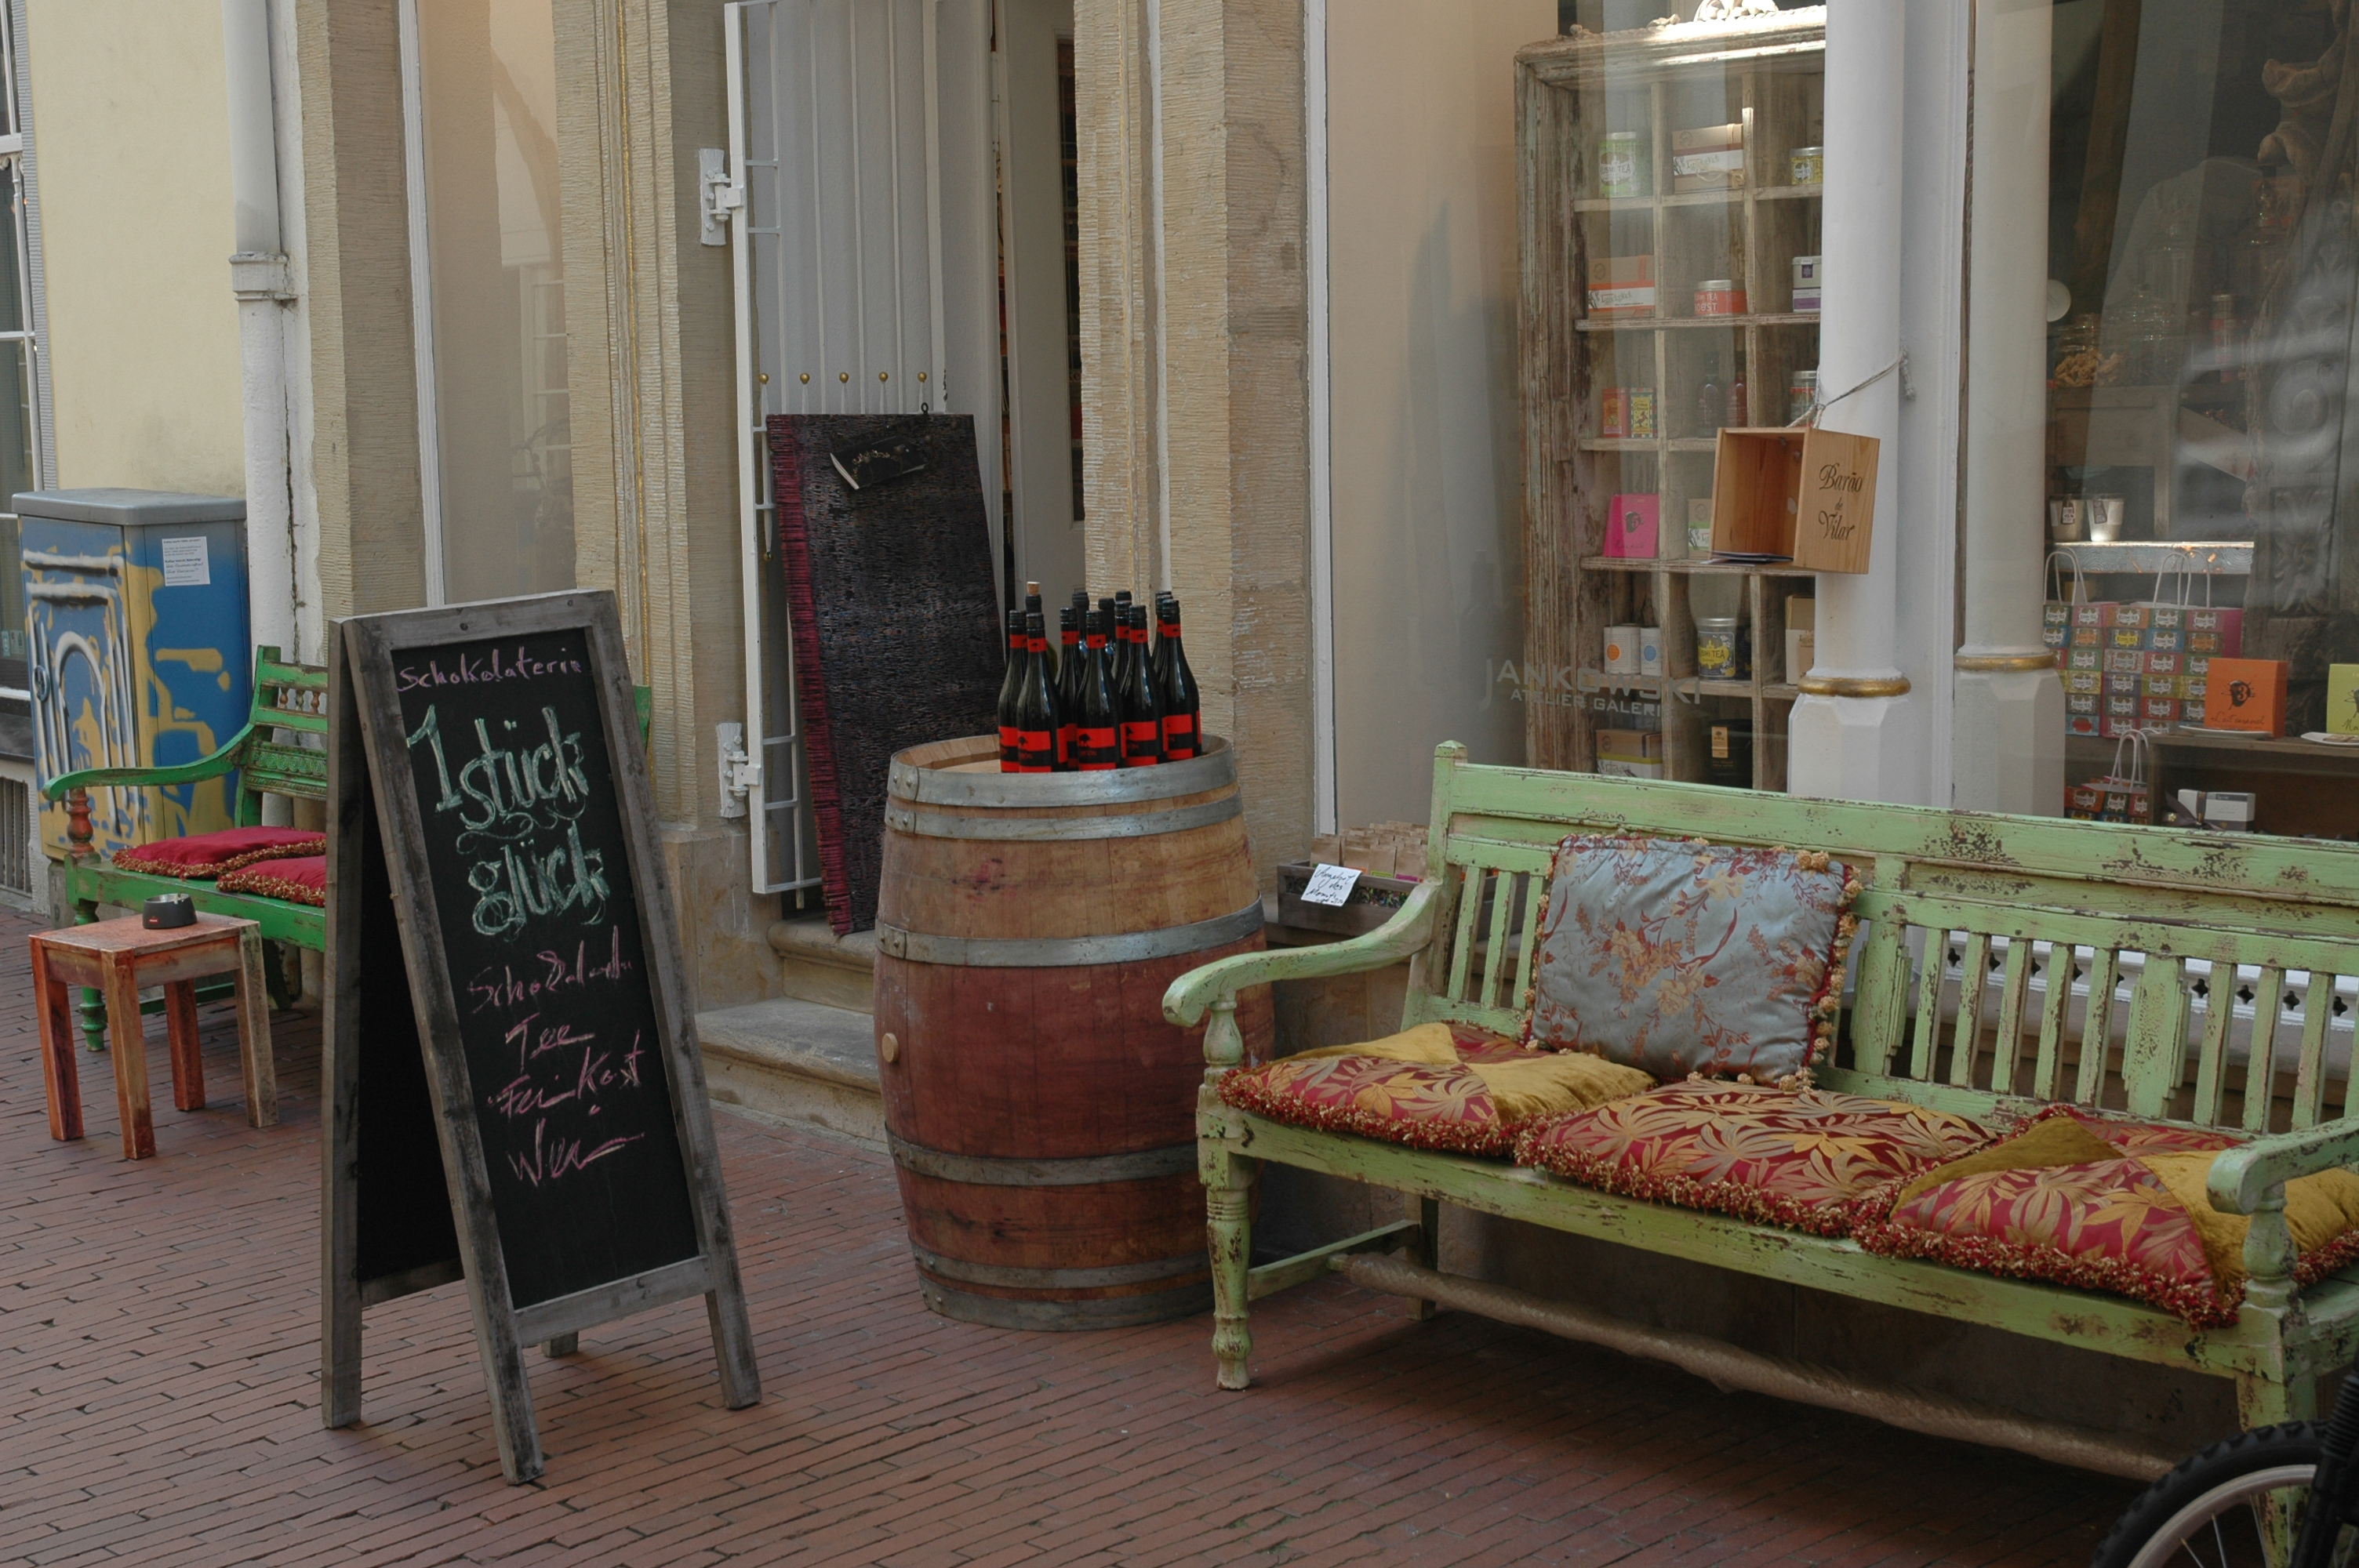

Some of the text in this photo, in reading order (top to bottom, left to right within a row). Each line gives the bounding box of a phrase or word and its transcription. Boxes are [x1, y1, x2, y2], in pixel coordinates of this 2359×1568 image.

[1617, 163, 1631, 173] TEA
[1695, 303, 1717, 312] OOST
[1819, 463, 1863, 492] Barão
[1835, 496, 1843, 510] de
[1819, 510, 1855, 540] Vilar
[1712, 649, 1725, 659] TEA
[1478, 658, 1700, 711] JANKOWSKI
[2237, 686, 2248, 702] 3
[1510, 688, 1586, 710] ATELIER
[406, 704, 463, 812] 1
[505, 1012, 595, 1074] Tee
